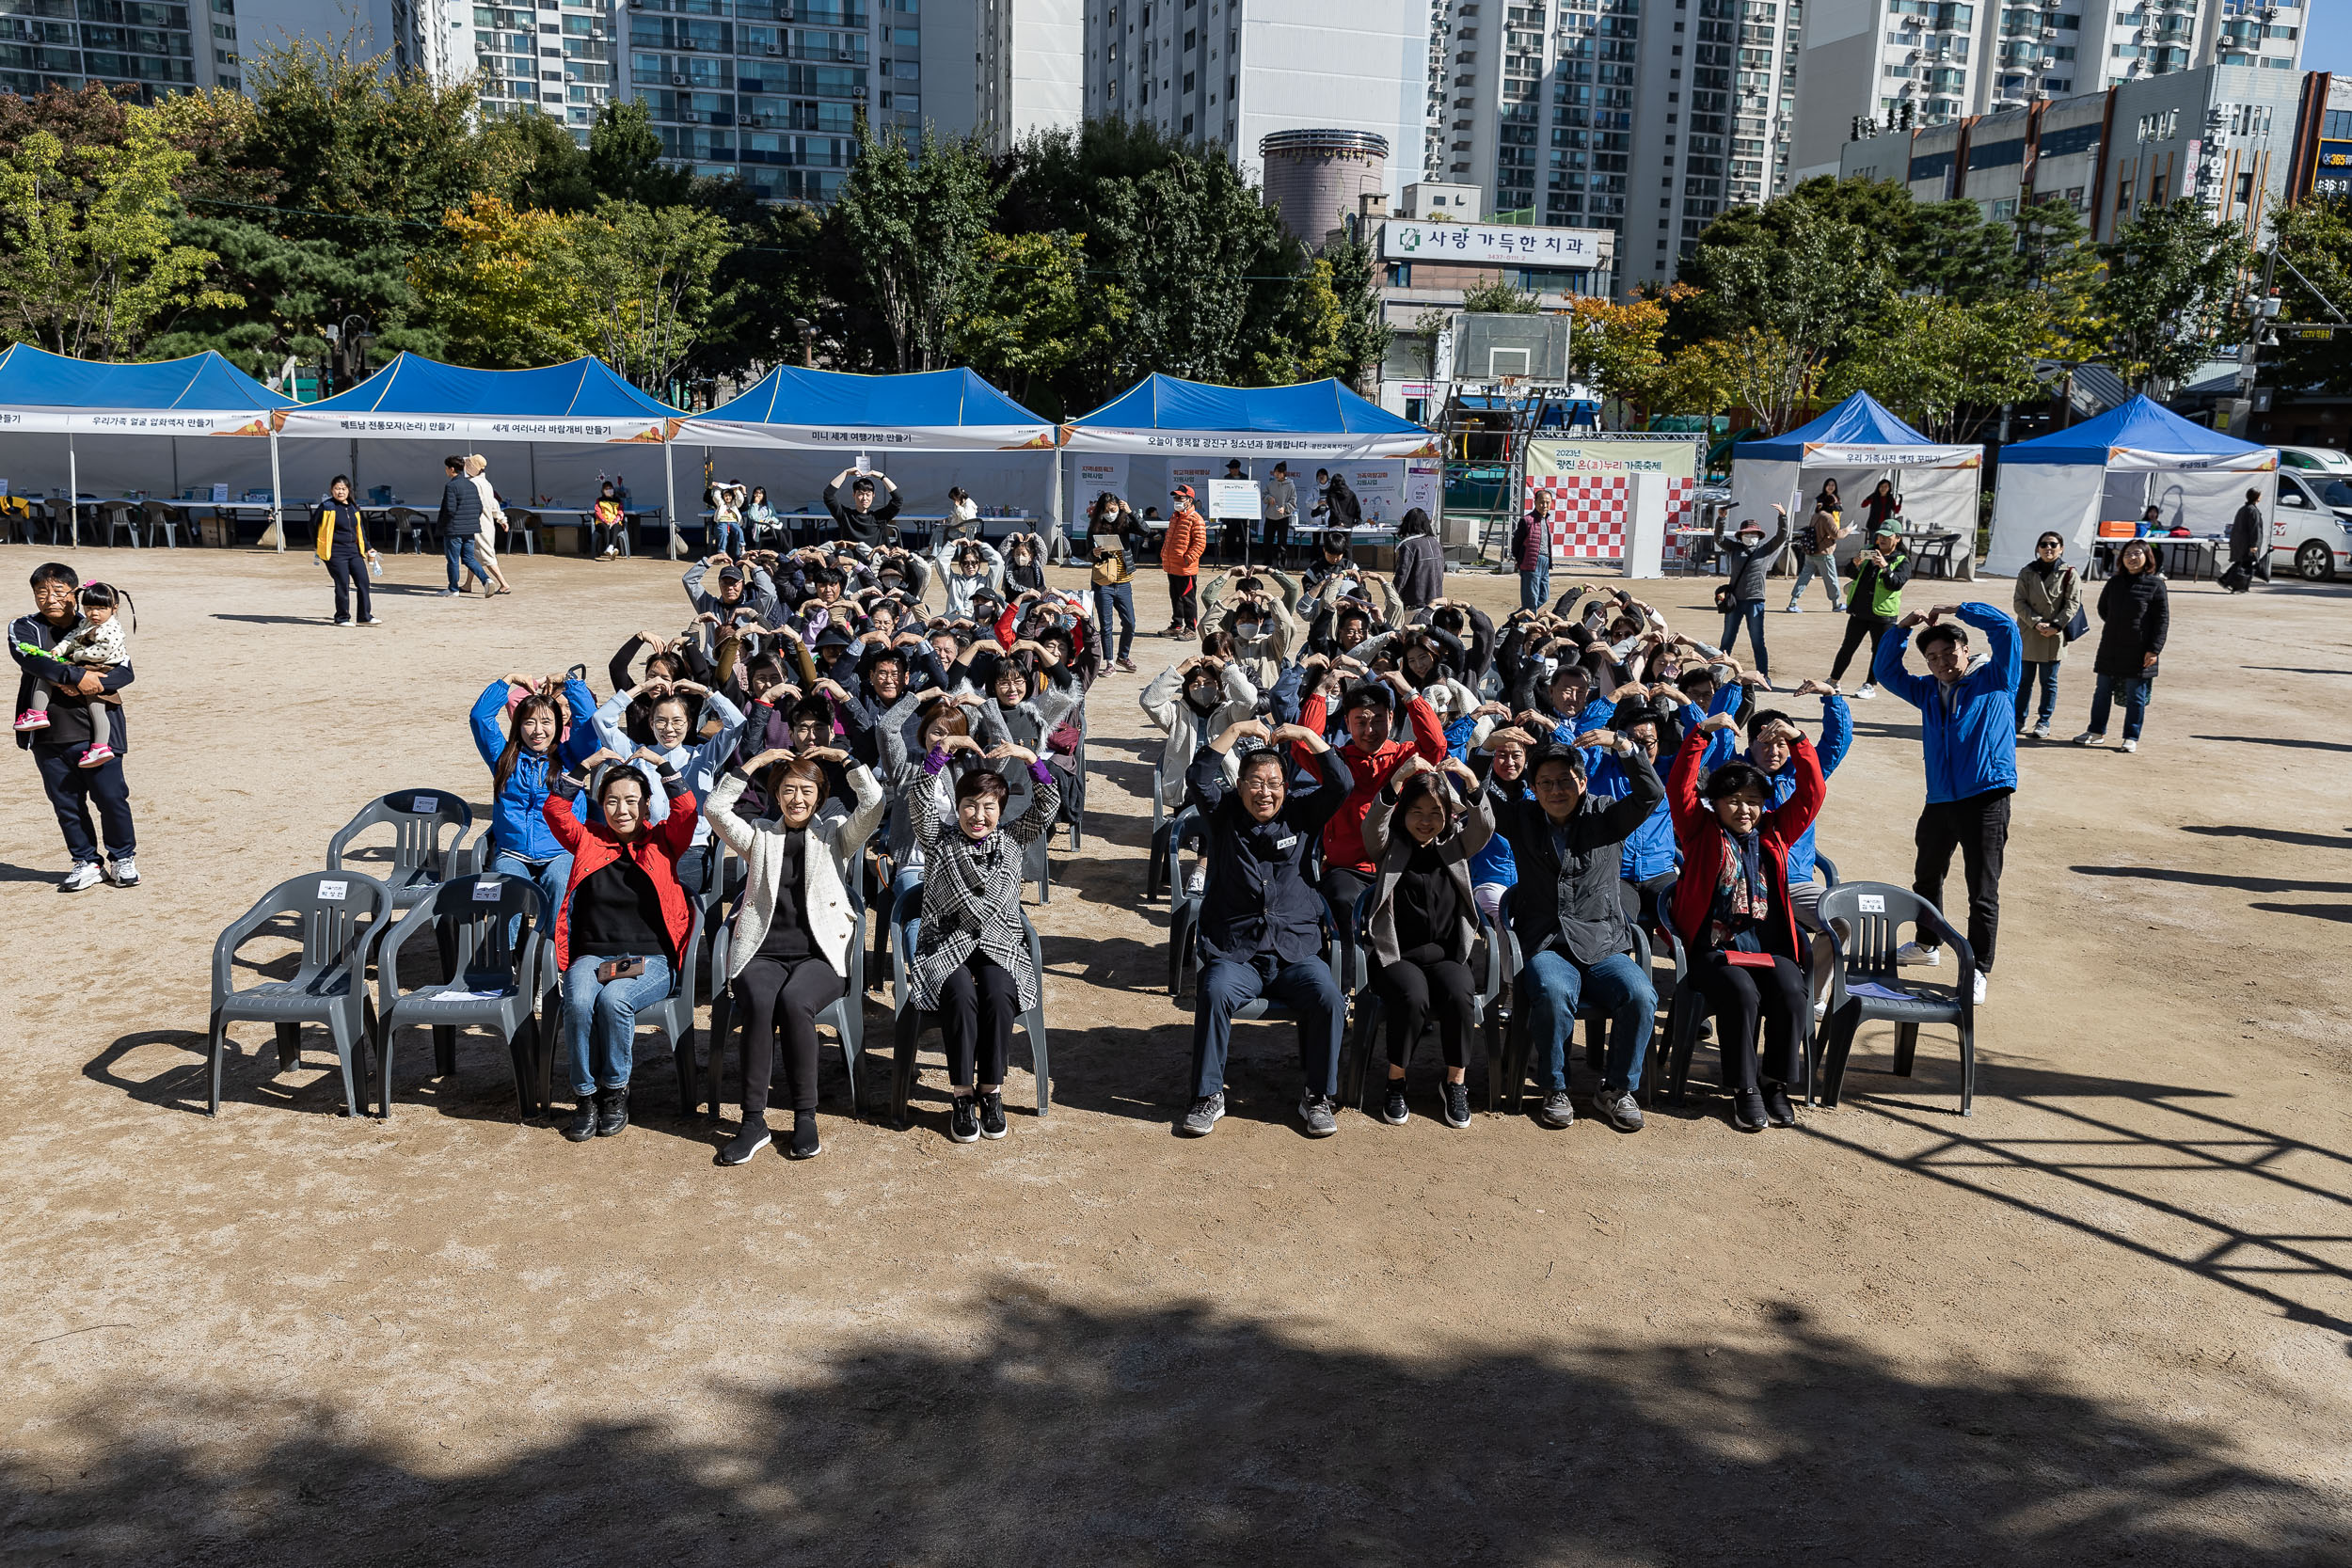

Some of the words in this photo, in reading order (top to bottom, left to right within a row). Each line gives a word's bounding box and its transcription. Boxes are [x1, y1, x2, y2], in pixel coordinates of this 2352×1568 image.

[2184, 161, 2198, 195] 사우나
[1428, 229, 1470, 249] 사랑
[1477, 232, 1537, 254] 가득한
[1544, 236, 1584, 255] 치과
[2301, 330, 2315, 339] CCTV
[92, 416, 128, 426] 우리가족
[130, 416, 148, 426] 얼굴
[187, 418, 215, 429] 만들기
[340, 420, 366, 431] 베트남
[429, 421, 455, 432] 만들기
[491, 423, 510, 433] 세계
[511, 423, 547, 434] 여러나라
[548, 424, 583, 436] 바람개비
[585, 425, 612, 436] 만들기
[811, 430, 829, 441] 미니
[831, 431, 849, 442] 세계
[850, 431, 883, 442] 여행가방
[886, 432, 912, 443] 만들기
[1147, 436, 1173, 447] 오늘이
[1175, 436, 1200, 448] 행복할
[1202, 438, 1228, 449] 광진구
[1230, 438, 1263, 450] 청소년과
[1265, 439, 1308, 450] 함께합니다
[1555, 449, 1581, 458] 2023년
[1846, 453, 1863, 464] 우리
[1864, 453, 1897, 465] 가족사진
[1899, 454, 1915, 465] 액자
[1556, 459, 1575, 471] 광진
[1625, 460, 1662, 471] 가족축제
